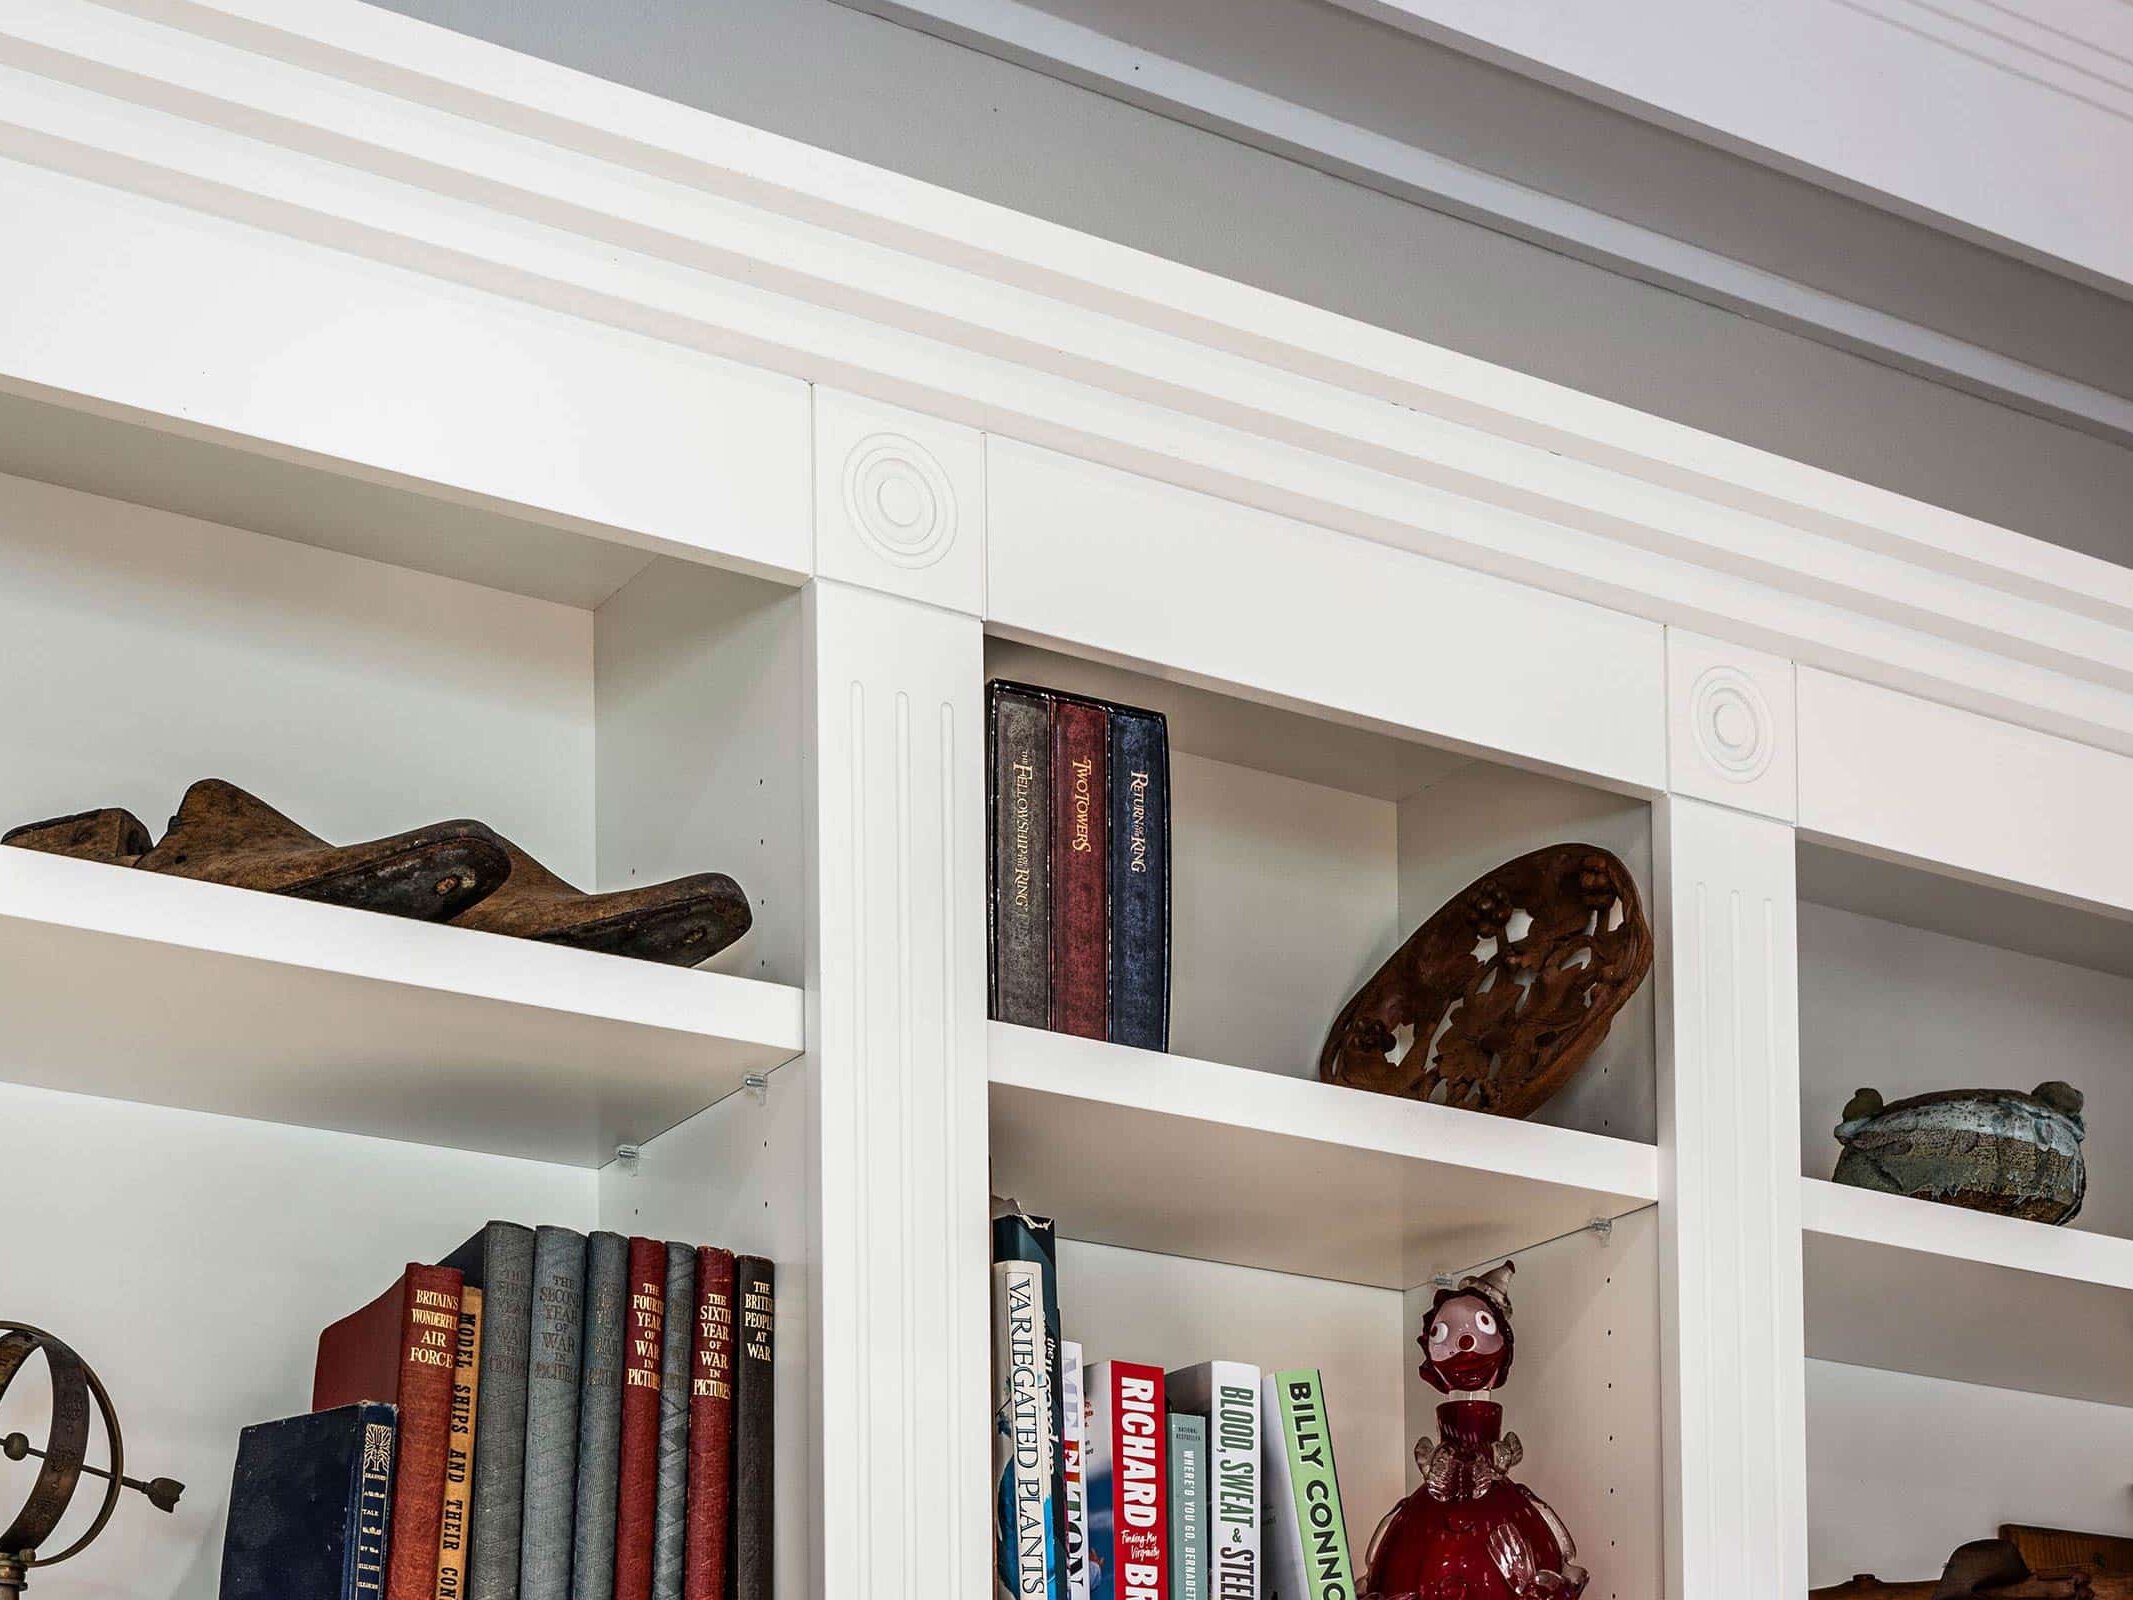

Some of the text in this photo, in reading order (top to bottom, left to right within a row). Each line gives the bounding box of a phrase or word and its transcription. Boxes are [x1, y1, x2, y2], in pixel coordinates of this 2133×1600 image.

[1013, 761, 1033, 857] FELLOWSHIP
[1072, 760, 1091, 852] TWO TOWERS
[1130, 770, 1149, 826] RETURN
[1130, 835, 1146, 873] KING
[1015, 866, 1030, 910] RING
[553, 1275, 575, 1289] THE
[643, 1283, 660, 1296] THE
[753, 1281, 770, 1295] THE
[708, 1293, 727, 1306] THE
[545, 1304, 578, 1327] YEAR
[700, 1305, 731, 1324] SIXTH
[421, 1330, 447, 1347] AIR
[555, 1322, 568, 1333] OF
[701, 1322, 729, 1341] YEAR
[755, 1331, 767, 1343] AT
[456, 1313, 476, 1368] MODEL
[541, 1331, 575, 1354] WAR
[634, 1340, 660, 1360] WAR
[709, 1340, 722, 1350] OF
[410, 1347, 454, 1368] FORCE
[700, 1351, 728, 1369] WAR
[747, 1343, 772, 1361] WAR
[643, 1360, 654, 1369] IN
[709, 1368, 721, 1378] IN
[451, 1384, 471, 1435] SHIPS
[1216, 1385, 1254, 1453] BLOOD,
[1289, 1382, 1324, 1468] BILLY
[1009, 1278, 1045, 1595] VARIEGATED PLANTS
[1122, 1377, 1157, 1527] RICHARD
[447, 1448, 466, 1483] AND
[1183, 1450, 1196, 1496] WHERE'D
[1220, 1459, 1254, 1528] SWEAT
[1064, 1440, 1084, 1587] ELTON
[1184, 1501, 1196, 1521] YOU
[442, 1500, 463, 1551] THEIR
[1232, 1528, 1242, 1543] &
